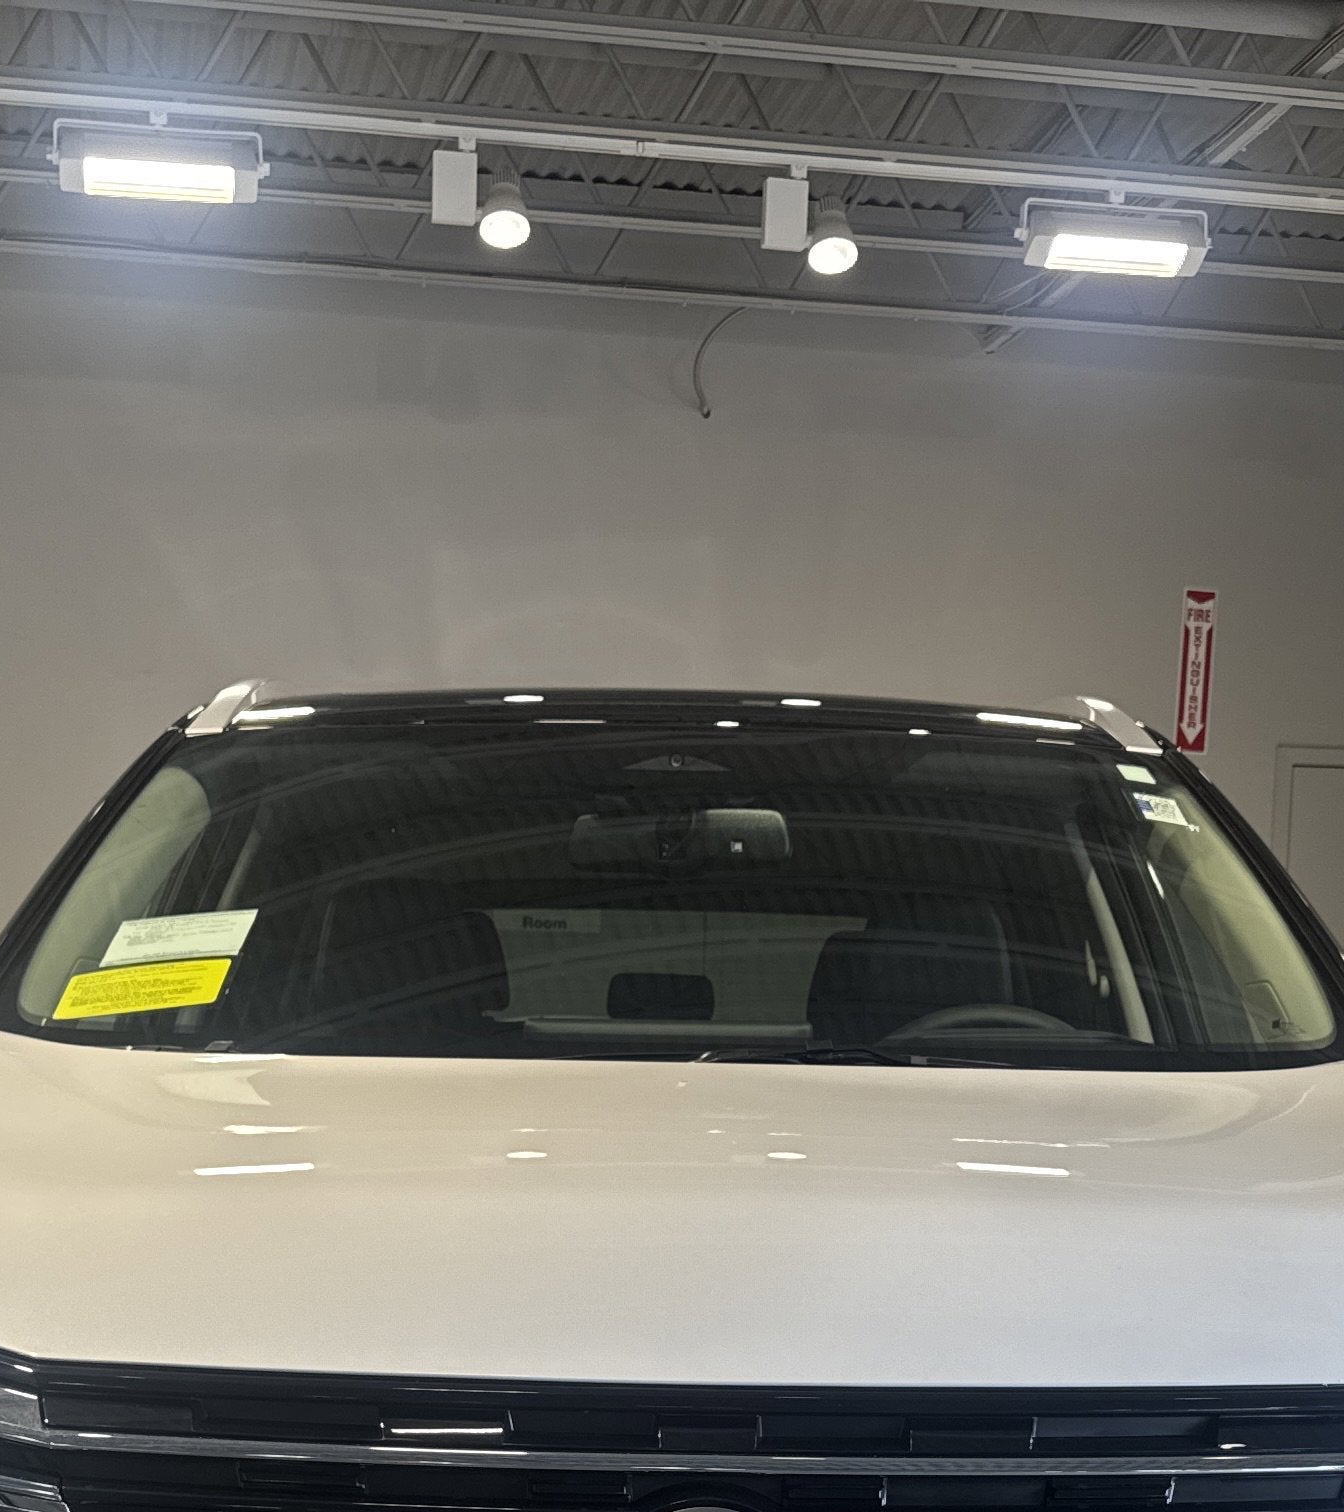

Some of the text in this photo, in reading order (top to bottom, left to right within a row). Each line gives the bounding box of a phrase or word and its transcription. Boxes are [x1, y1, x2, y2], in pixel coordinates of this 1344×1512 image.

[1188, 608, 1211, 623] FIRE
[1188, 626, 1202, 729] EXTINGUISHER
[522, 916, 567, 929] Room
